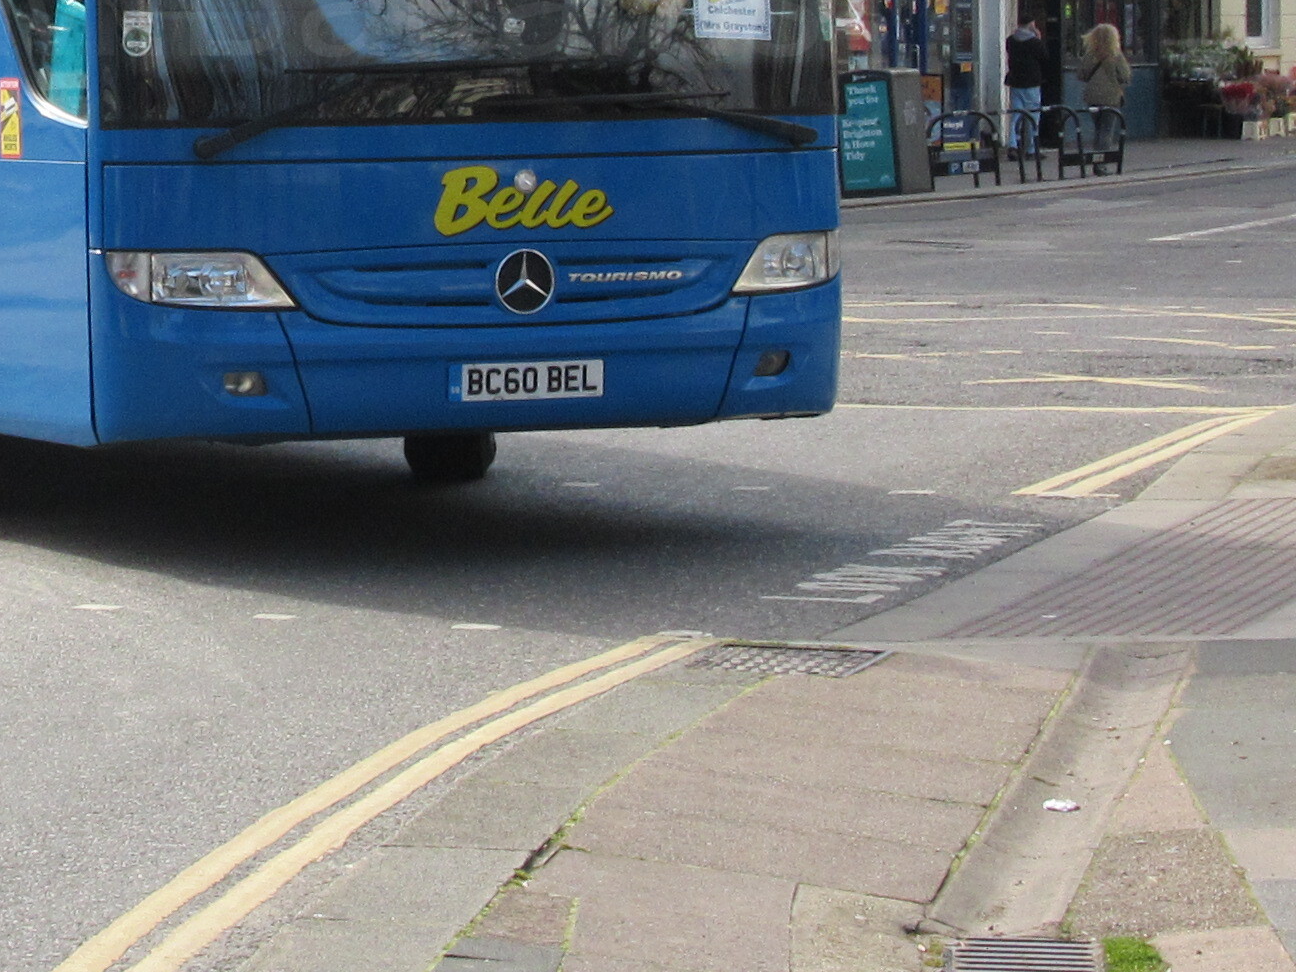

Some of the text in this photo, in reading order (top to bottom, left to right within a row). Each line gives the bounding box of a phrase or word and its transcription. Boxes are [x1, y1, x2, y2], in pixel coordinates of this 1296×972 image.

[434, 166, 614, 237] Belle
[568, 270, 683, 283] TOURISMO
[467, 364, 598, 396] BC60 BEL
